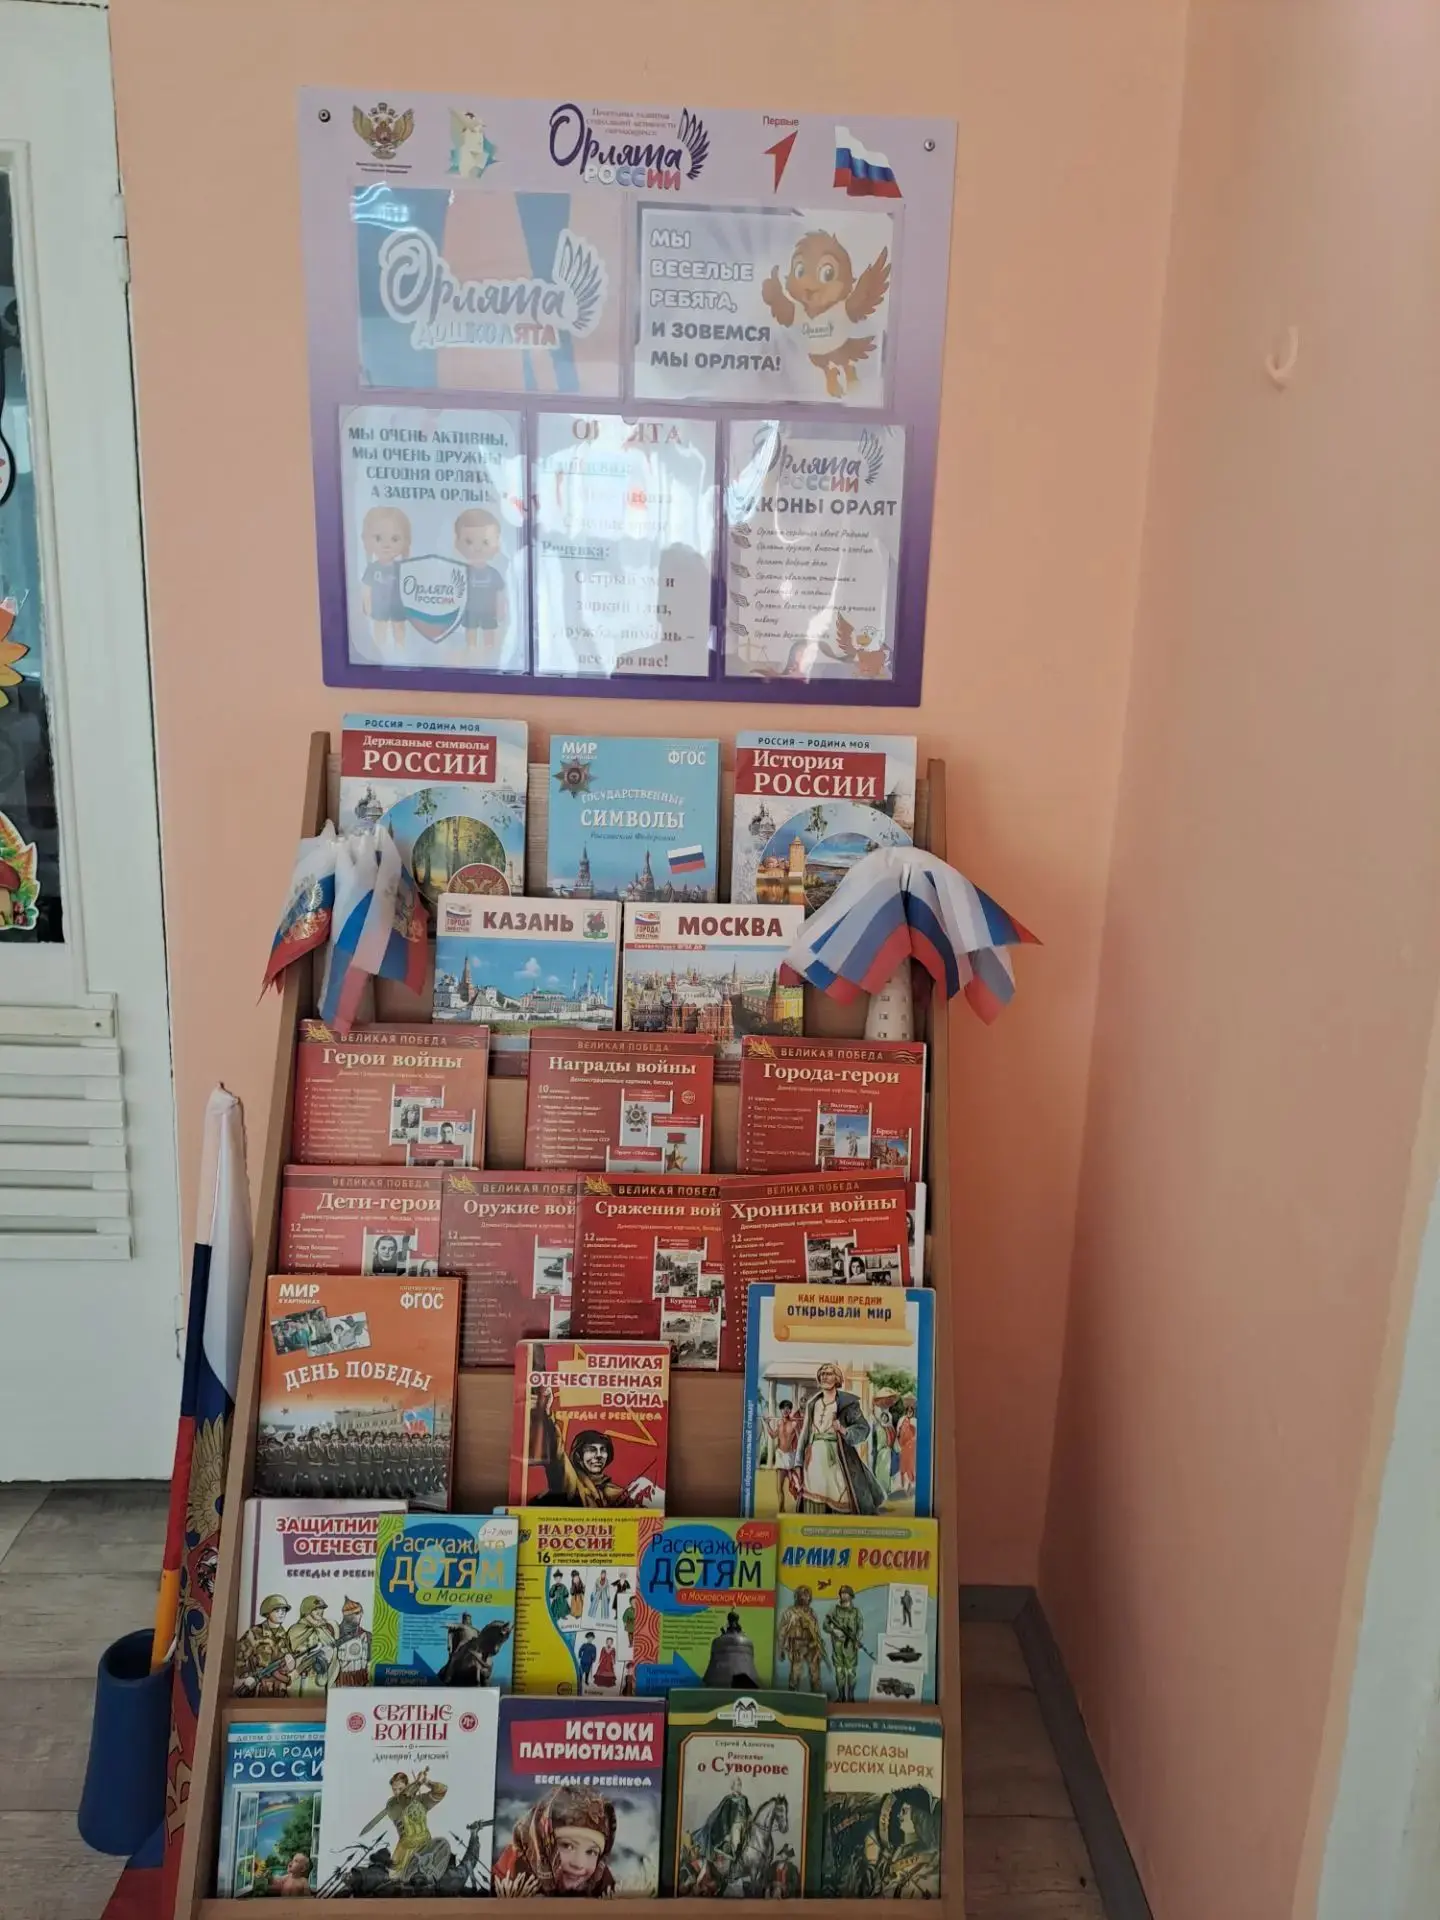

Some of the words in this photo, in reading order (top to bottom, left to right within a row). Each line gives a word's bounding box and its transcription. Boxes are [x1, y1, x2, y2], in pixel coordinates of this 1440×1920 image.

[762, 115, 799, 126] Первые
[549, 103, 683, 175] Орлята
[583, 165, 681, 191] РОССИИ
[651, 229, 690, 248] МЫ
[384, 228, 566, 323] Орлята
[651, 260, 753, 281] ВЕСЕЛЫЕ
[650, 289, 737, 313] РЕБЯТА,
[652, 322, 664, 338] И
[671, 323, 771, 342] ЗОВЕМСЯ
[651, 351, 687, 368] МЫ
[695, 353, 781, 371] ОРЛЯТА!
[349, 427, 374, 441] МЫ
[379, 428, 428, 443] ОЧЕНЬ
[432, 431, 508, 448] АКТИВНЫ,
[352, 446, 378, 460] МЫ
[383, 449, 431, 462] ОЧЕНЬ
[366, 466, 430, 481] СЕГОДНЯ
[371, 485, 380, 498] А
[384, 486, 436, 500] ЗАВТРА
[831, 500, 898, 517] ОРЛЯТ
[403, 575, 454, 602] Орлята
[665, 576, 675, 588] и
[417, 595, 456, 605] РОССИИ
[638, 654, 669, 668] нас!
[365, 719, 403, 728] РОССИЯ
[416, 722, 457, 732] РОДИНА
[460, 723, 480, 733] МОЯ
[362, 735, 433, 749] Державные
[435, 740, 490, 751] символы
[758, 737, 795, 746] РОССИЯ
[807, 739, 846, 748] РОДИНА
[849, 741, 870, 749] МОЯ
[562, 741, 598, 755] МИР
[668, 750, 706, 766] ФГОС
[752, 750, 844, 773] История
[362, 750, 488, 776] РОССИИ
[753, 772, 877, 798] РОССИИ
[581, 788, 686, 807] ГОСУДАРСТВЕННЫЕ
[581, 809, 686, 829] СИМВОЛЫ
[483, 911, 574, 932] КАЗАНЬ
[678, 916, 783, 937] МОСКВА
[341, 1033, 396, 1044] ВЕЛИКАЯ
[400, 1036, 447, 1046] ПОБЕДА
[577, 1041, 625, 1051] ВЕЛИКАЯ
[628, 1044, 670, 1052] ПОБЕДА
[323, 1048, 386, 1069] Герои
[392, 1051, 464, 1069] войны
[781, 1047, 834, 1058] ВЕЛИКАЯ
[838, 1050, 884, 1060] ПОБЕДА
[549, 1056, 630, 1075] Награды
[637, 1058, 697, 1075] войны
[763, 1062, 900, 1086] Города-герои
[332, 1177, 383, 1187] ВЕЛИКАЯ
[387, 1179, 430, 1189] ПОБЕДА
[482, 1183, 538, 1193] ВЕЛИКАЯ
[542, 1185, 576, 1195] ПОБЕ
[767, 1184, 815, 1195] ВЕЛИКАЯ
[818, 1183, 860, 1192] ПОБЕДА
[619, 1186, 674, 1195] ВЕЛИКАЯ
[677, 1187, 721, 1197] ПОБЕД
[316, 1192, 441, 1214] Дети-герои
[463, 1199, 541, 1217] Оружие
[595, 1201, 685, 1217] Сражения
[690, 1203, 721, 1216] вой
[730, 1202, 824, 1221] Хроники
[830, 1195, 897, 1213] войны
[290, 1223, 301, 1232] 12
[448, 1231, 458, 1240] 12
[584, 1232, 595, 1241] 12
[731, 1234, 742, 1242] 12
[279, 1283, 320, 1298] МИР
[400, 1293, 445, 1309] ФГОС
[798, 1294, 816, 1303] КАК
[819, 1294, 845, 1304] НАШИ
[847, 1295, 883, 1306] ПРЕДКИ
[588, 1355, 663, 1370] ВЕЛИКАЯ
[284, 1362, 340, 1391] ДЕНЬ
[345, 1361, 433, 1392] ПОБЕДЫ
[529, 1373, 663, 1388] ОТЕЧЕСТВЕННАЯ
[603, 1390, 663, 1407] ВОЙНА
[538, 1524, 614, 1536] НАРОДЫ
[295, 1538, 377, 1554] ОТЕЧЕСТ
[392, 1532, 507, 1555] Расскажите
[538, 1537, 614, 1550] РОССИИ
[652, 1533, 763, 1556] Расскажите
[538, 1551, 551, 1563] 16
[782, 1546, 851, 1568] АРМИЯ
[857, 1549, 931, 1570] РОССИИ
[287, 1569, 331, 1579] БЕСЕДЫ
[334, 1569, 340, 1577] С
[422, 1592, 431, 1601] о
[436, 1590, 493, 1604] Москве
[681, 1593, 686, 1601] о
[687, 1591, 734, 1602] Московском
[373, 1704, 453, 1722] СВЯТЫЕ
[373, 1722, 449, 1741] ВОИНЫ
[566, 1720, 654, 1742] ИСТОКИ
[234, 1748, 277, 1759] НАША
[283, 1746, 323, 1758] РОДИ
[519, 1742, 654, 1762] ПАТРИОТИЗМА
[727, 1751, 764, 1761] Рассказы
[837, 1744, 908, 1759] РАССКАЗЫ
[233, 1760, 325, 1779] РОССИ
[697, 1762, 706, 1772] о
[711, 1756, 789, 1777] Суворове
[825, 1761, 885, 1775] РУССКИХ
[889, 1764, 934, 1779] ЦАРЯХ
[534, 1774, 581, 1786] БЕСЕДЫ
